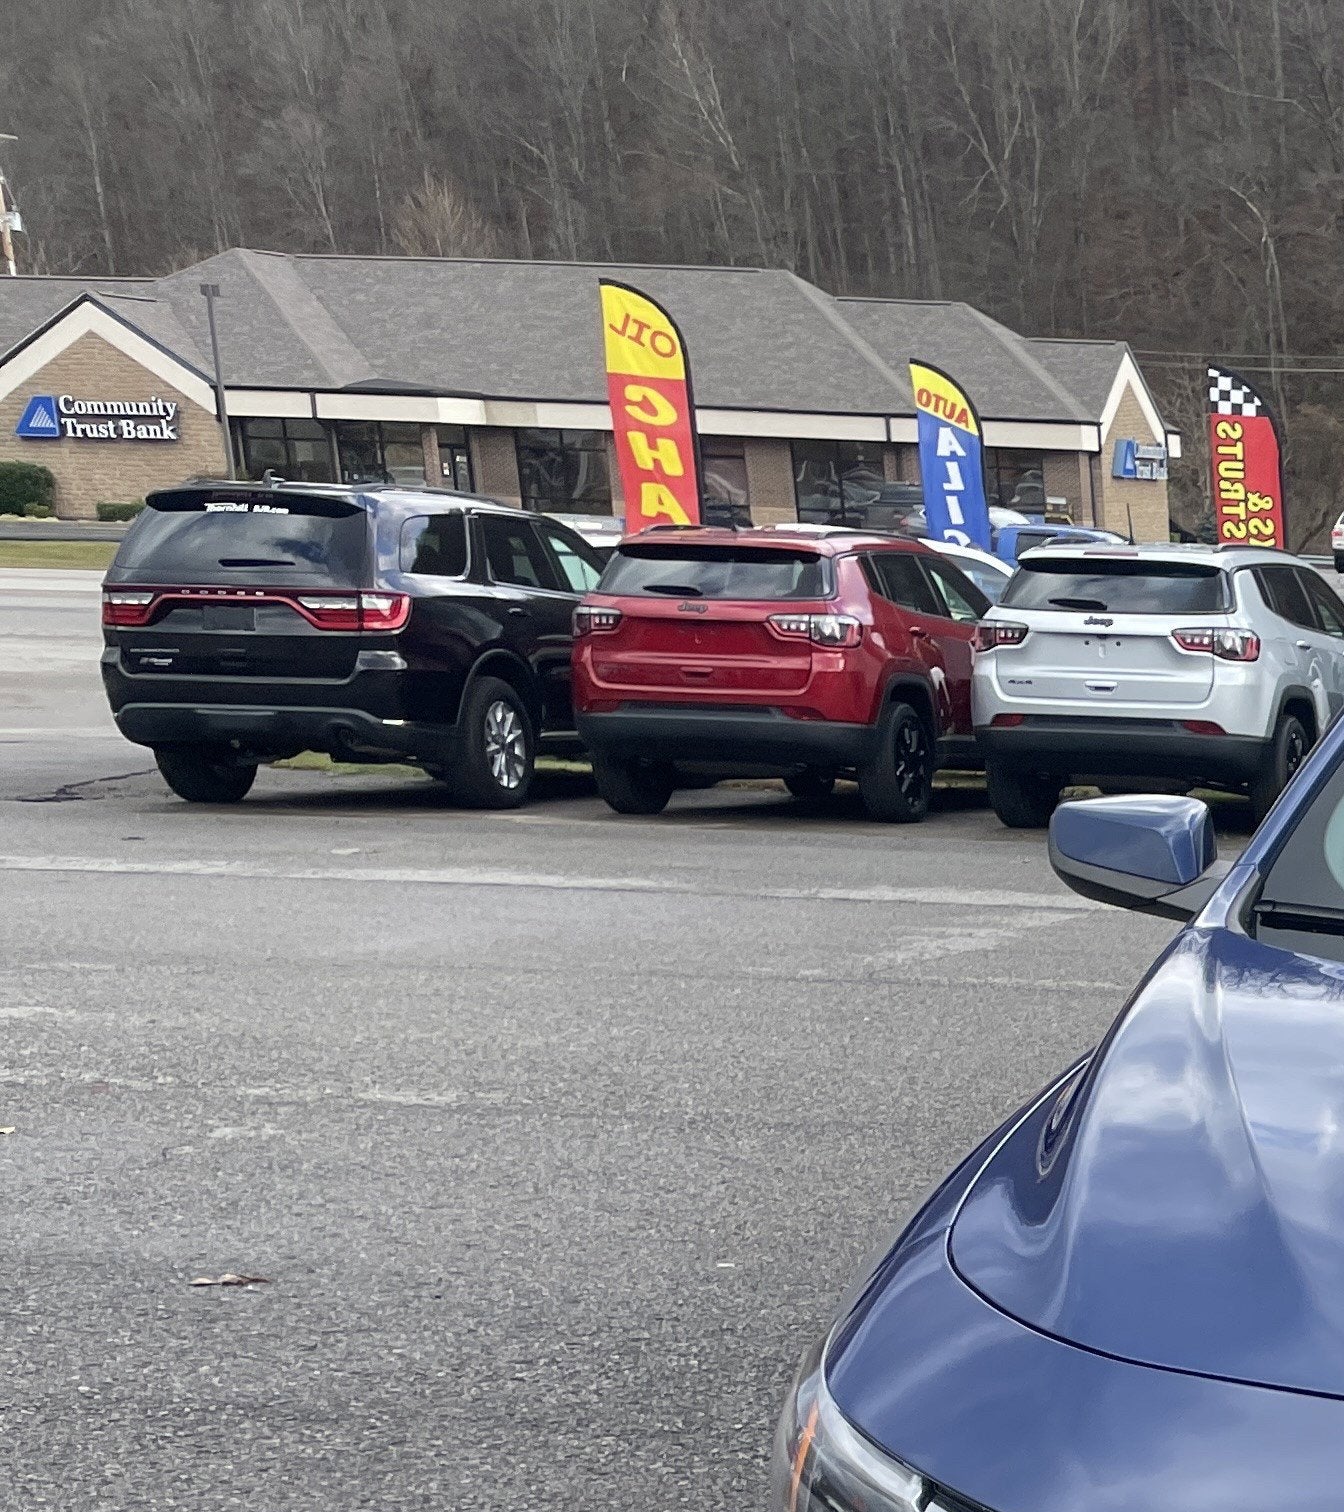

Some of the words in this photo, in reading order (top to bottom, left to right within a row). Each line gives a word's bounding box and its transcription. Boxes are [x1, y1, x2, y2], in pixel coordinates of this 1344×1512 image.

[58, 394, 177, 420] Community
[60, 417, 118, 438] Trust
[119, 419, 178, 440] Bank
